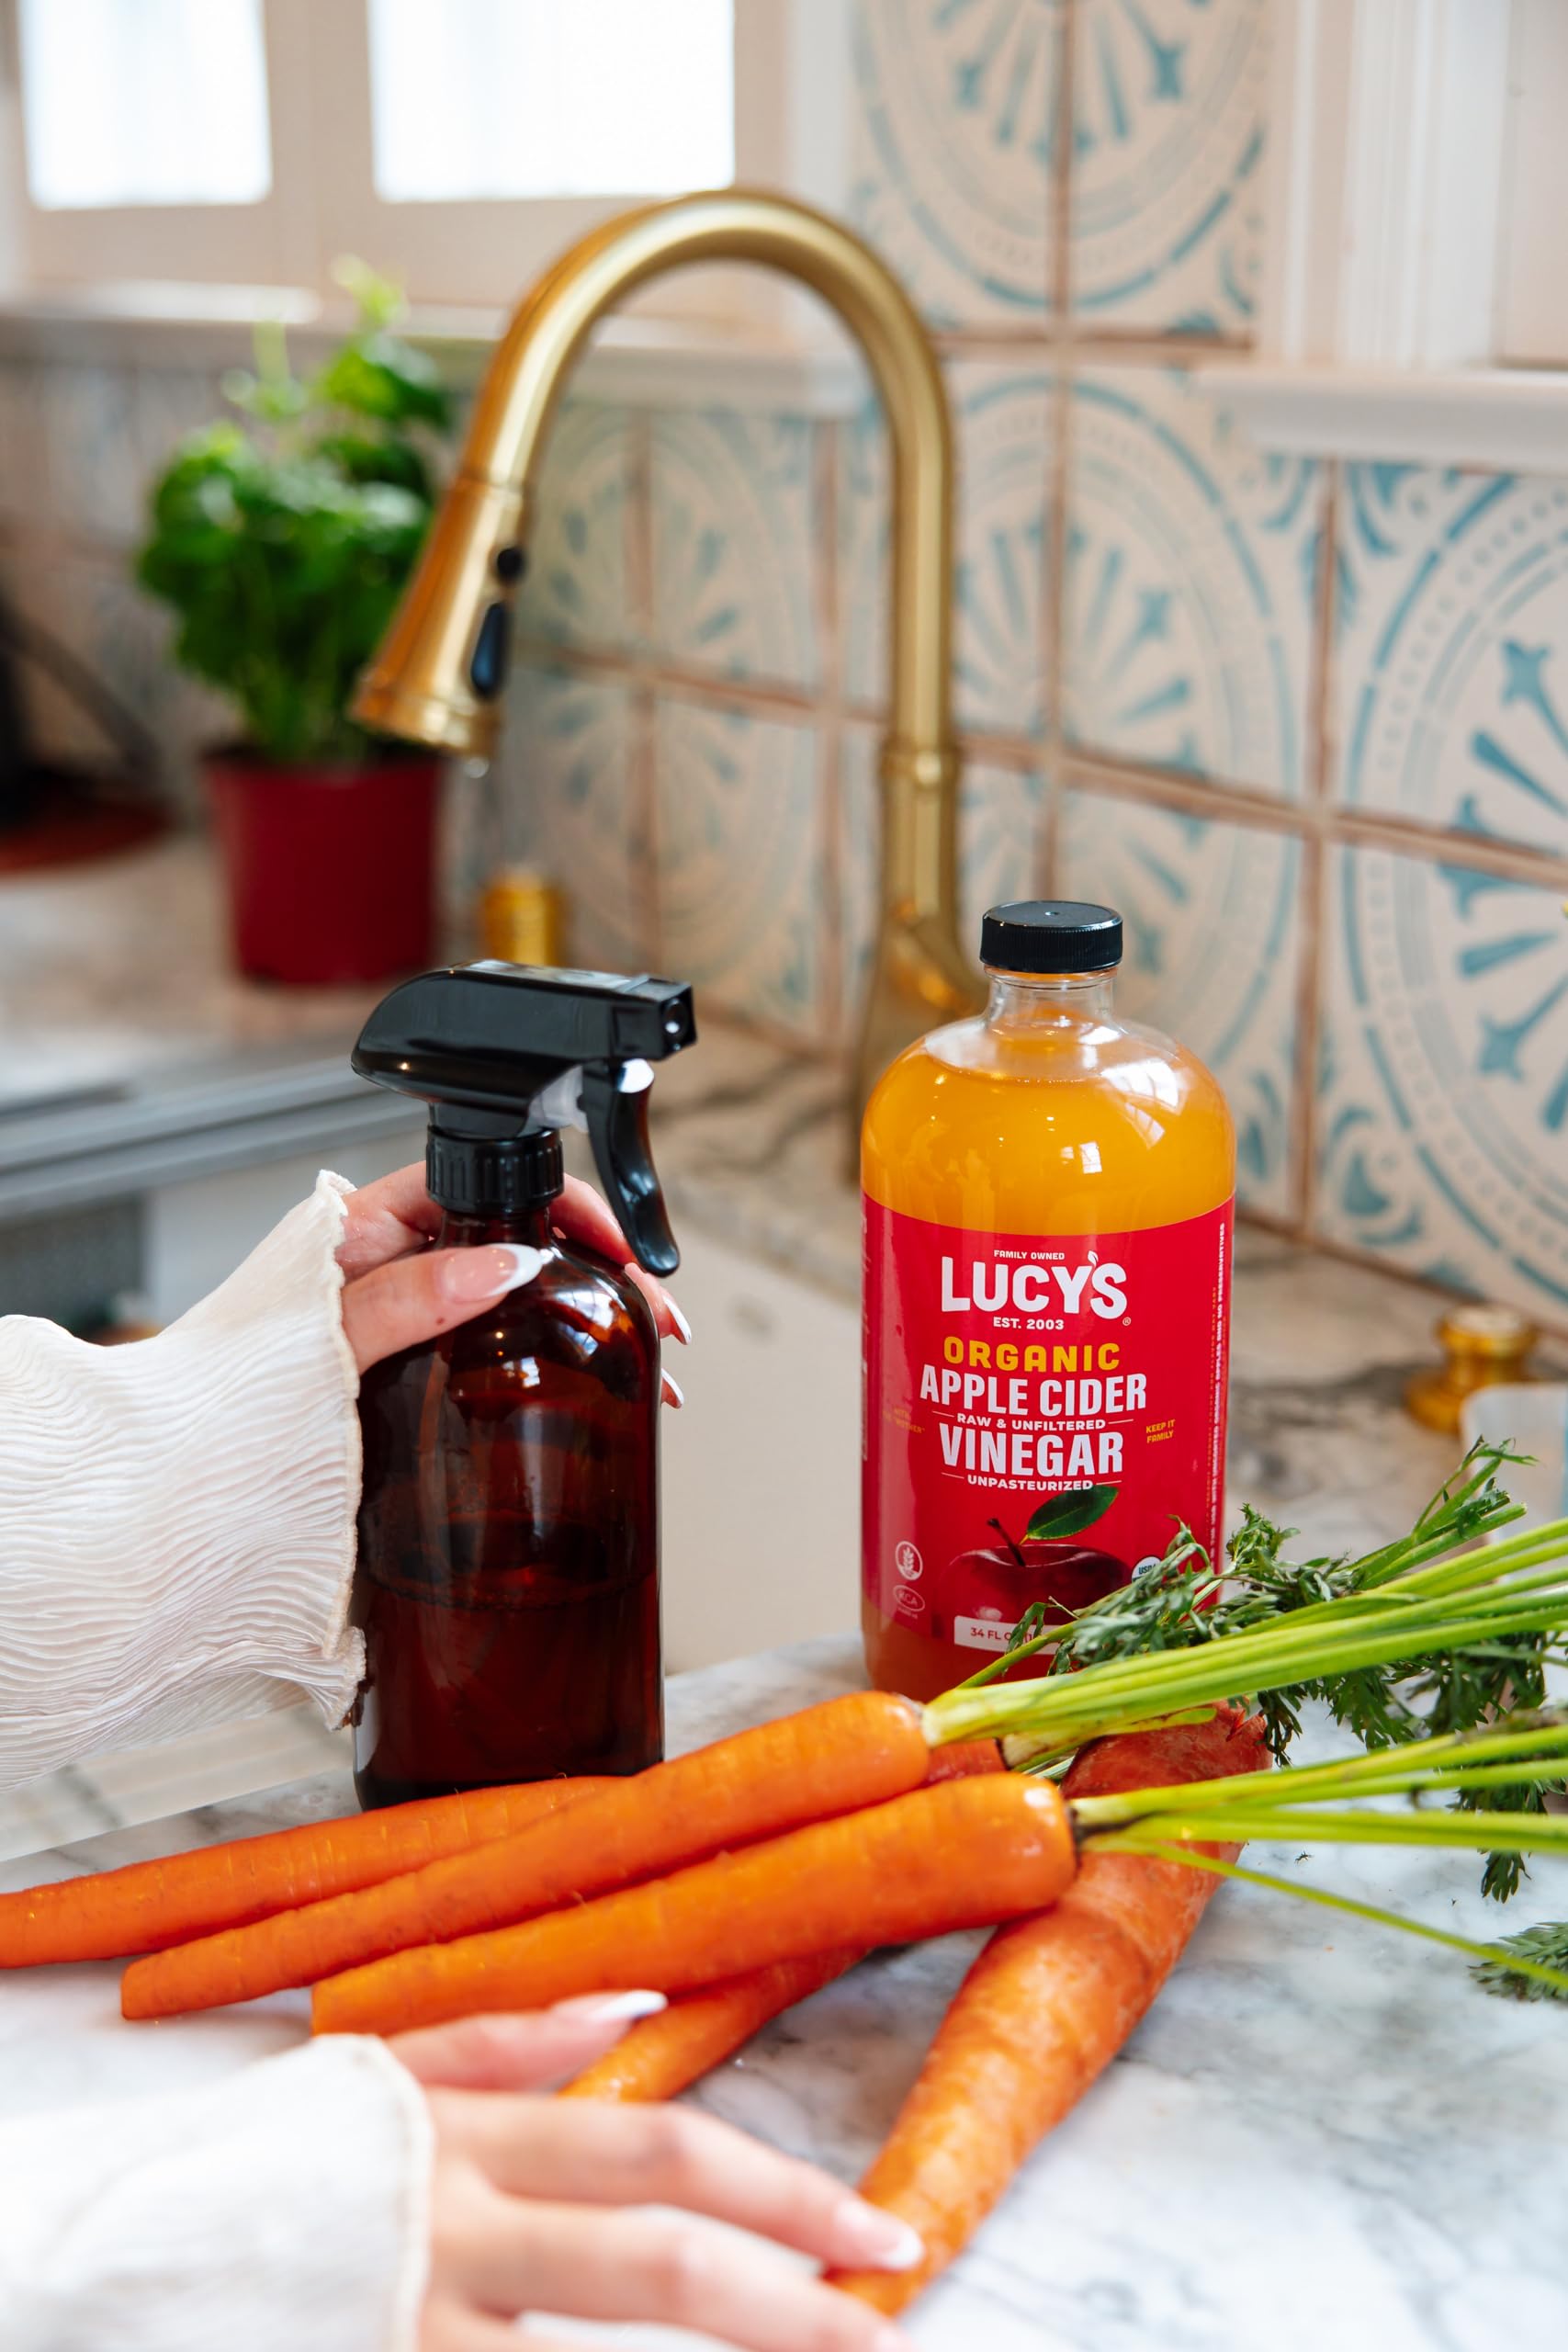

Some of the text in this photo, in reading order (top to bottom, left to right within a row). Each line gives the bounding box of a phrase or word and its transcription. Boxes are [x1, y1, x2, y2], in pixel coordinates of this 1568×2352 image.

[994, 1250, 1066, 1261] FAMILY OWNED
[993, 1317, 1065, 1330] EST. 2003
[943, 1336, 1121, 1373] ORGANIC
[919, 1363, 1147, 1417] APPLE CIDER
[957, 1413, 1106, 1431] RAW & UNFILTERED
[1145, 1419, 1176, 1434] KEEP IT
[1146, 1430, 1174, 1444] FAMILY
[939, 1422, 1124, 1477] VINEGAR
[967, 1474, 1094, 1491] UNPASTEURIZED
[970, 1627, 985, 1639] 34
[987, 1630, 1001, 1641] FL
